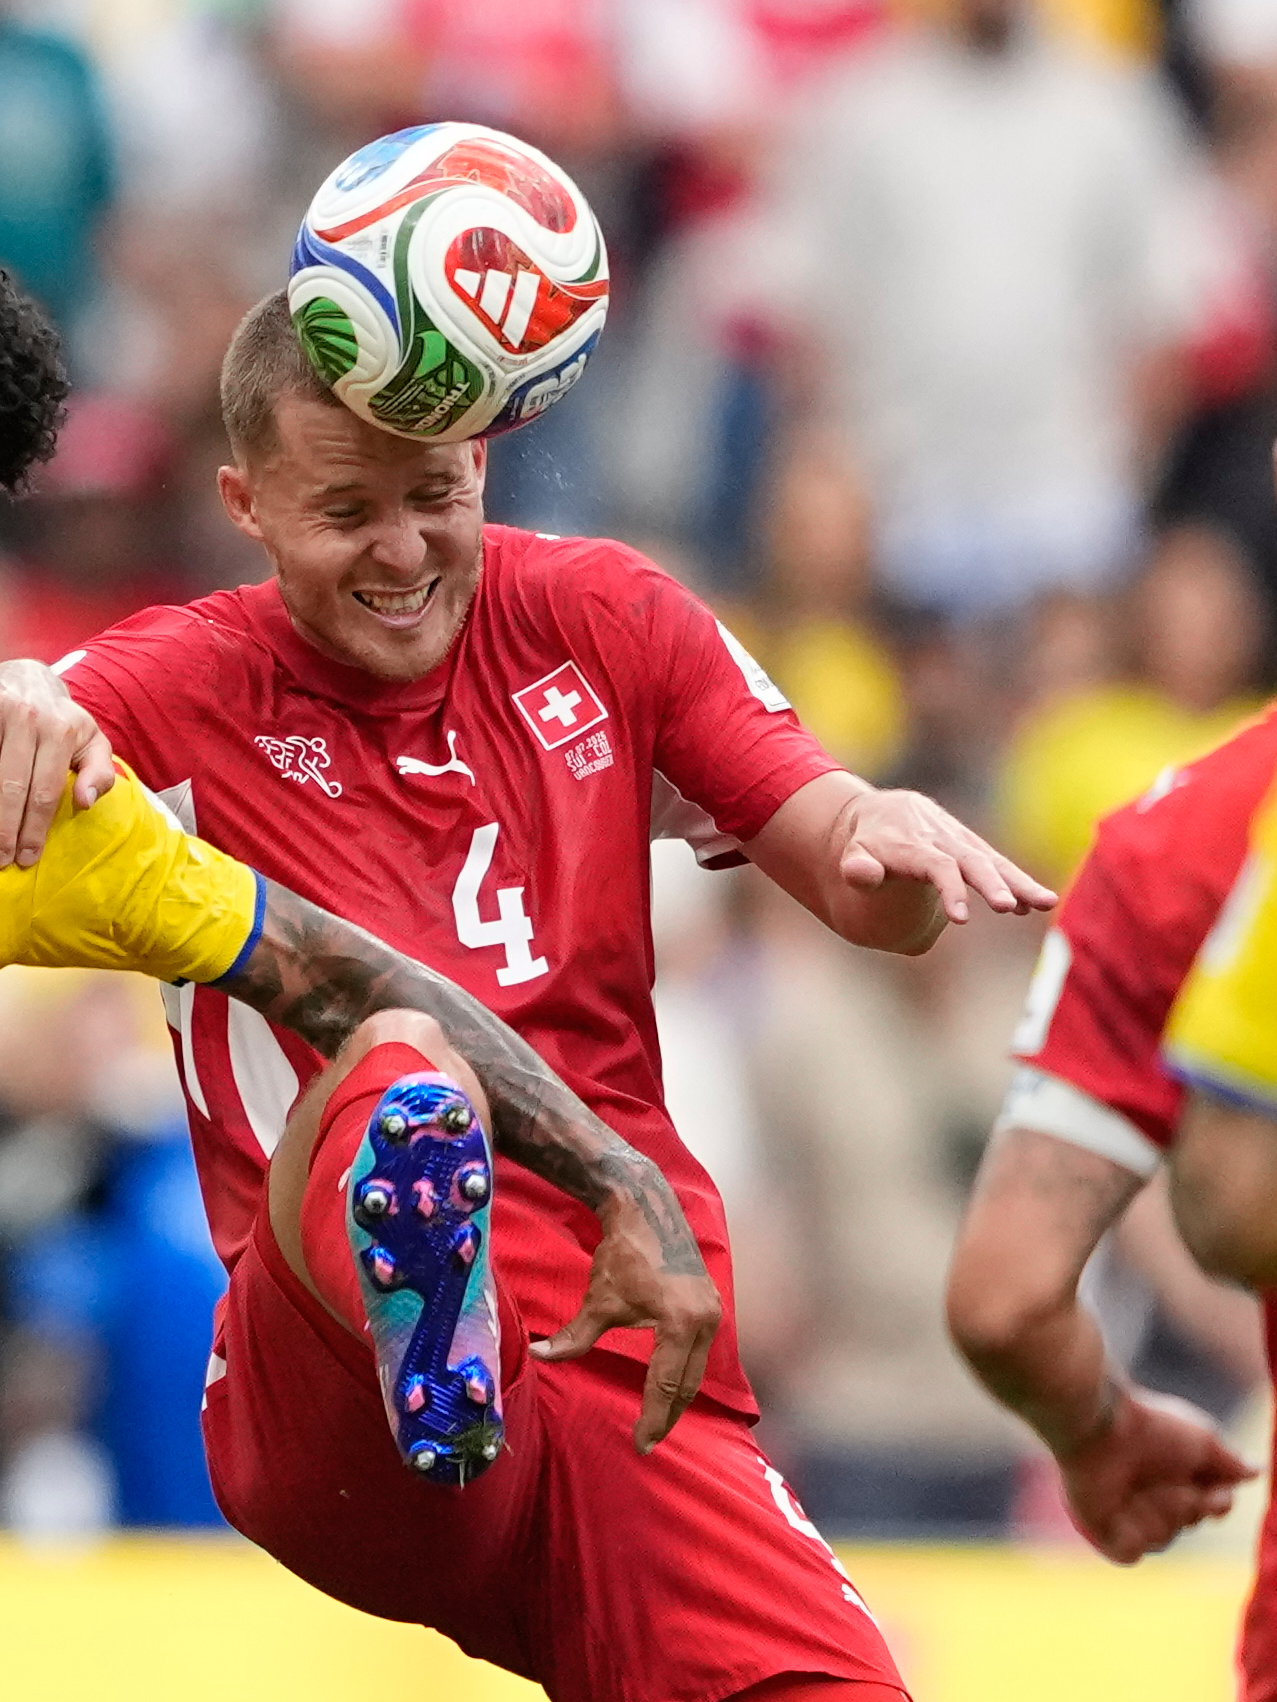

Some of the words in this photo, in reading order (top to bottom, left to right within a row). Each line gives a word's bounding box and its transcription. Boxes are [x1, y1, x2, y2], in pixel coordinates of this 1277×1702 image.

[567, 753, 587, 773] SUI
[592, 739, 613, 758] COL
[451, 821, 549, 987] 4
